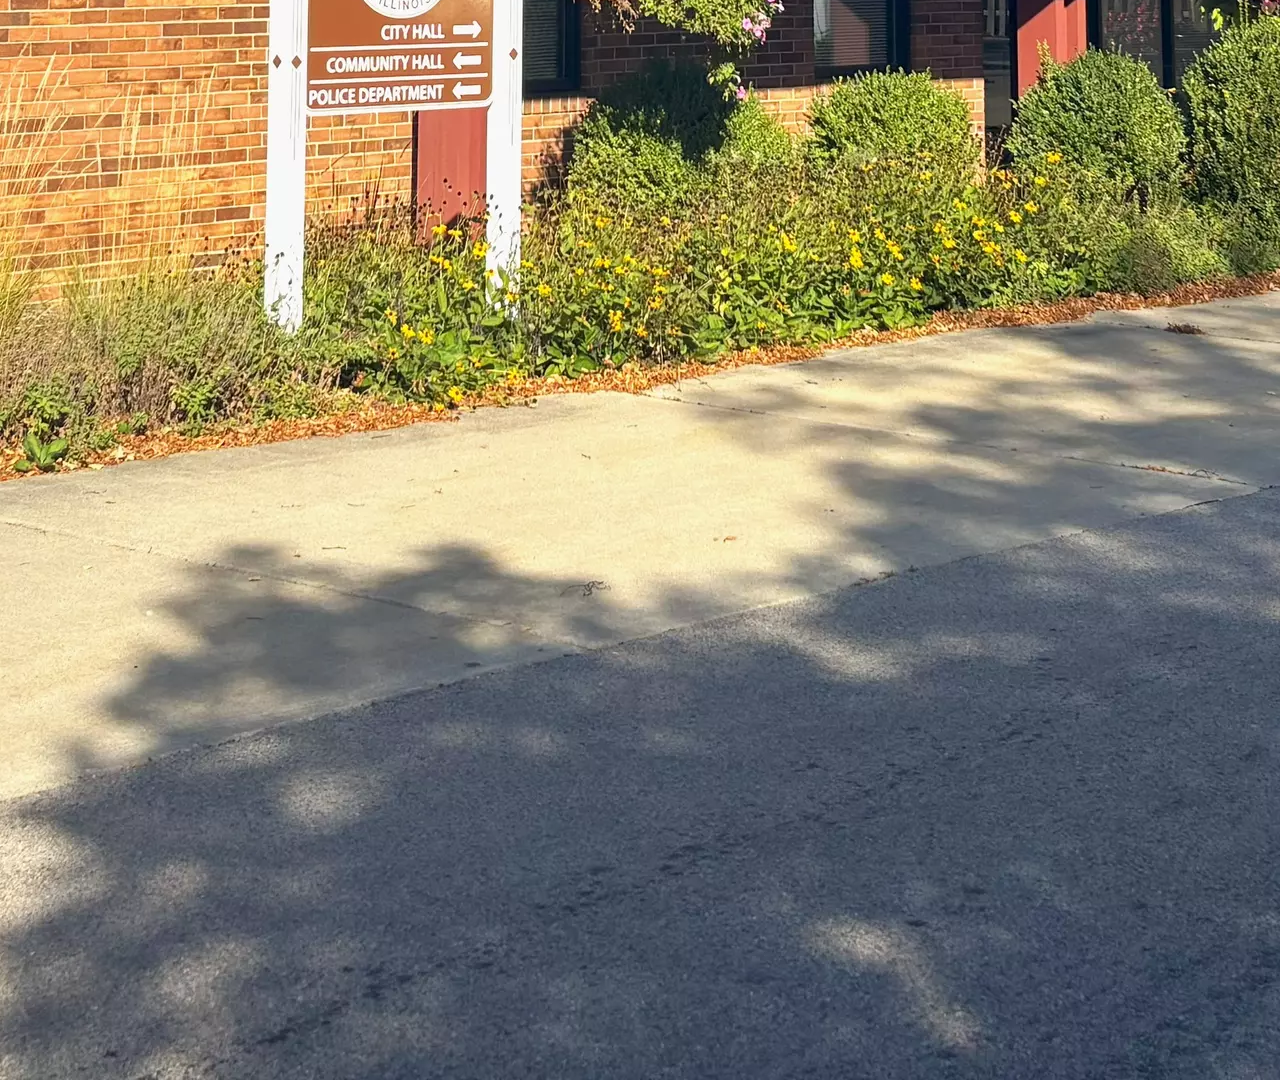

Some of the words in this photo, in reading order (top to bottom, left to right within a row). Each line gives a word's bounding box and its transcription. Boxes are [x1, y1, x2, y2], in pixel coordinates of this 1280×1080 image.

[380, 24, 410, 41] CITY
[412, 23, 445, 40] HALL
[326, 55, 410, 73] COMMUNITY
[412, 53, 445, 70] HALL
[308, 88, 356, 106] POLICE
[358, 84, 445, 103] DEPARTMENT
